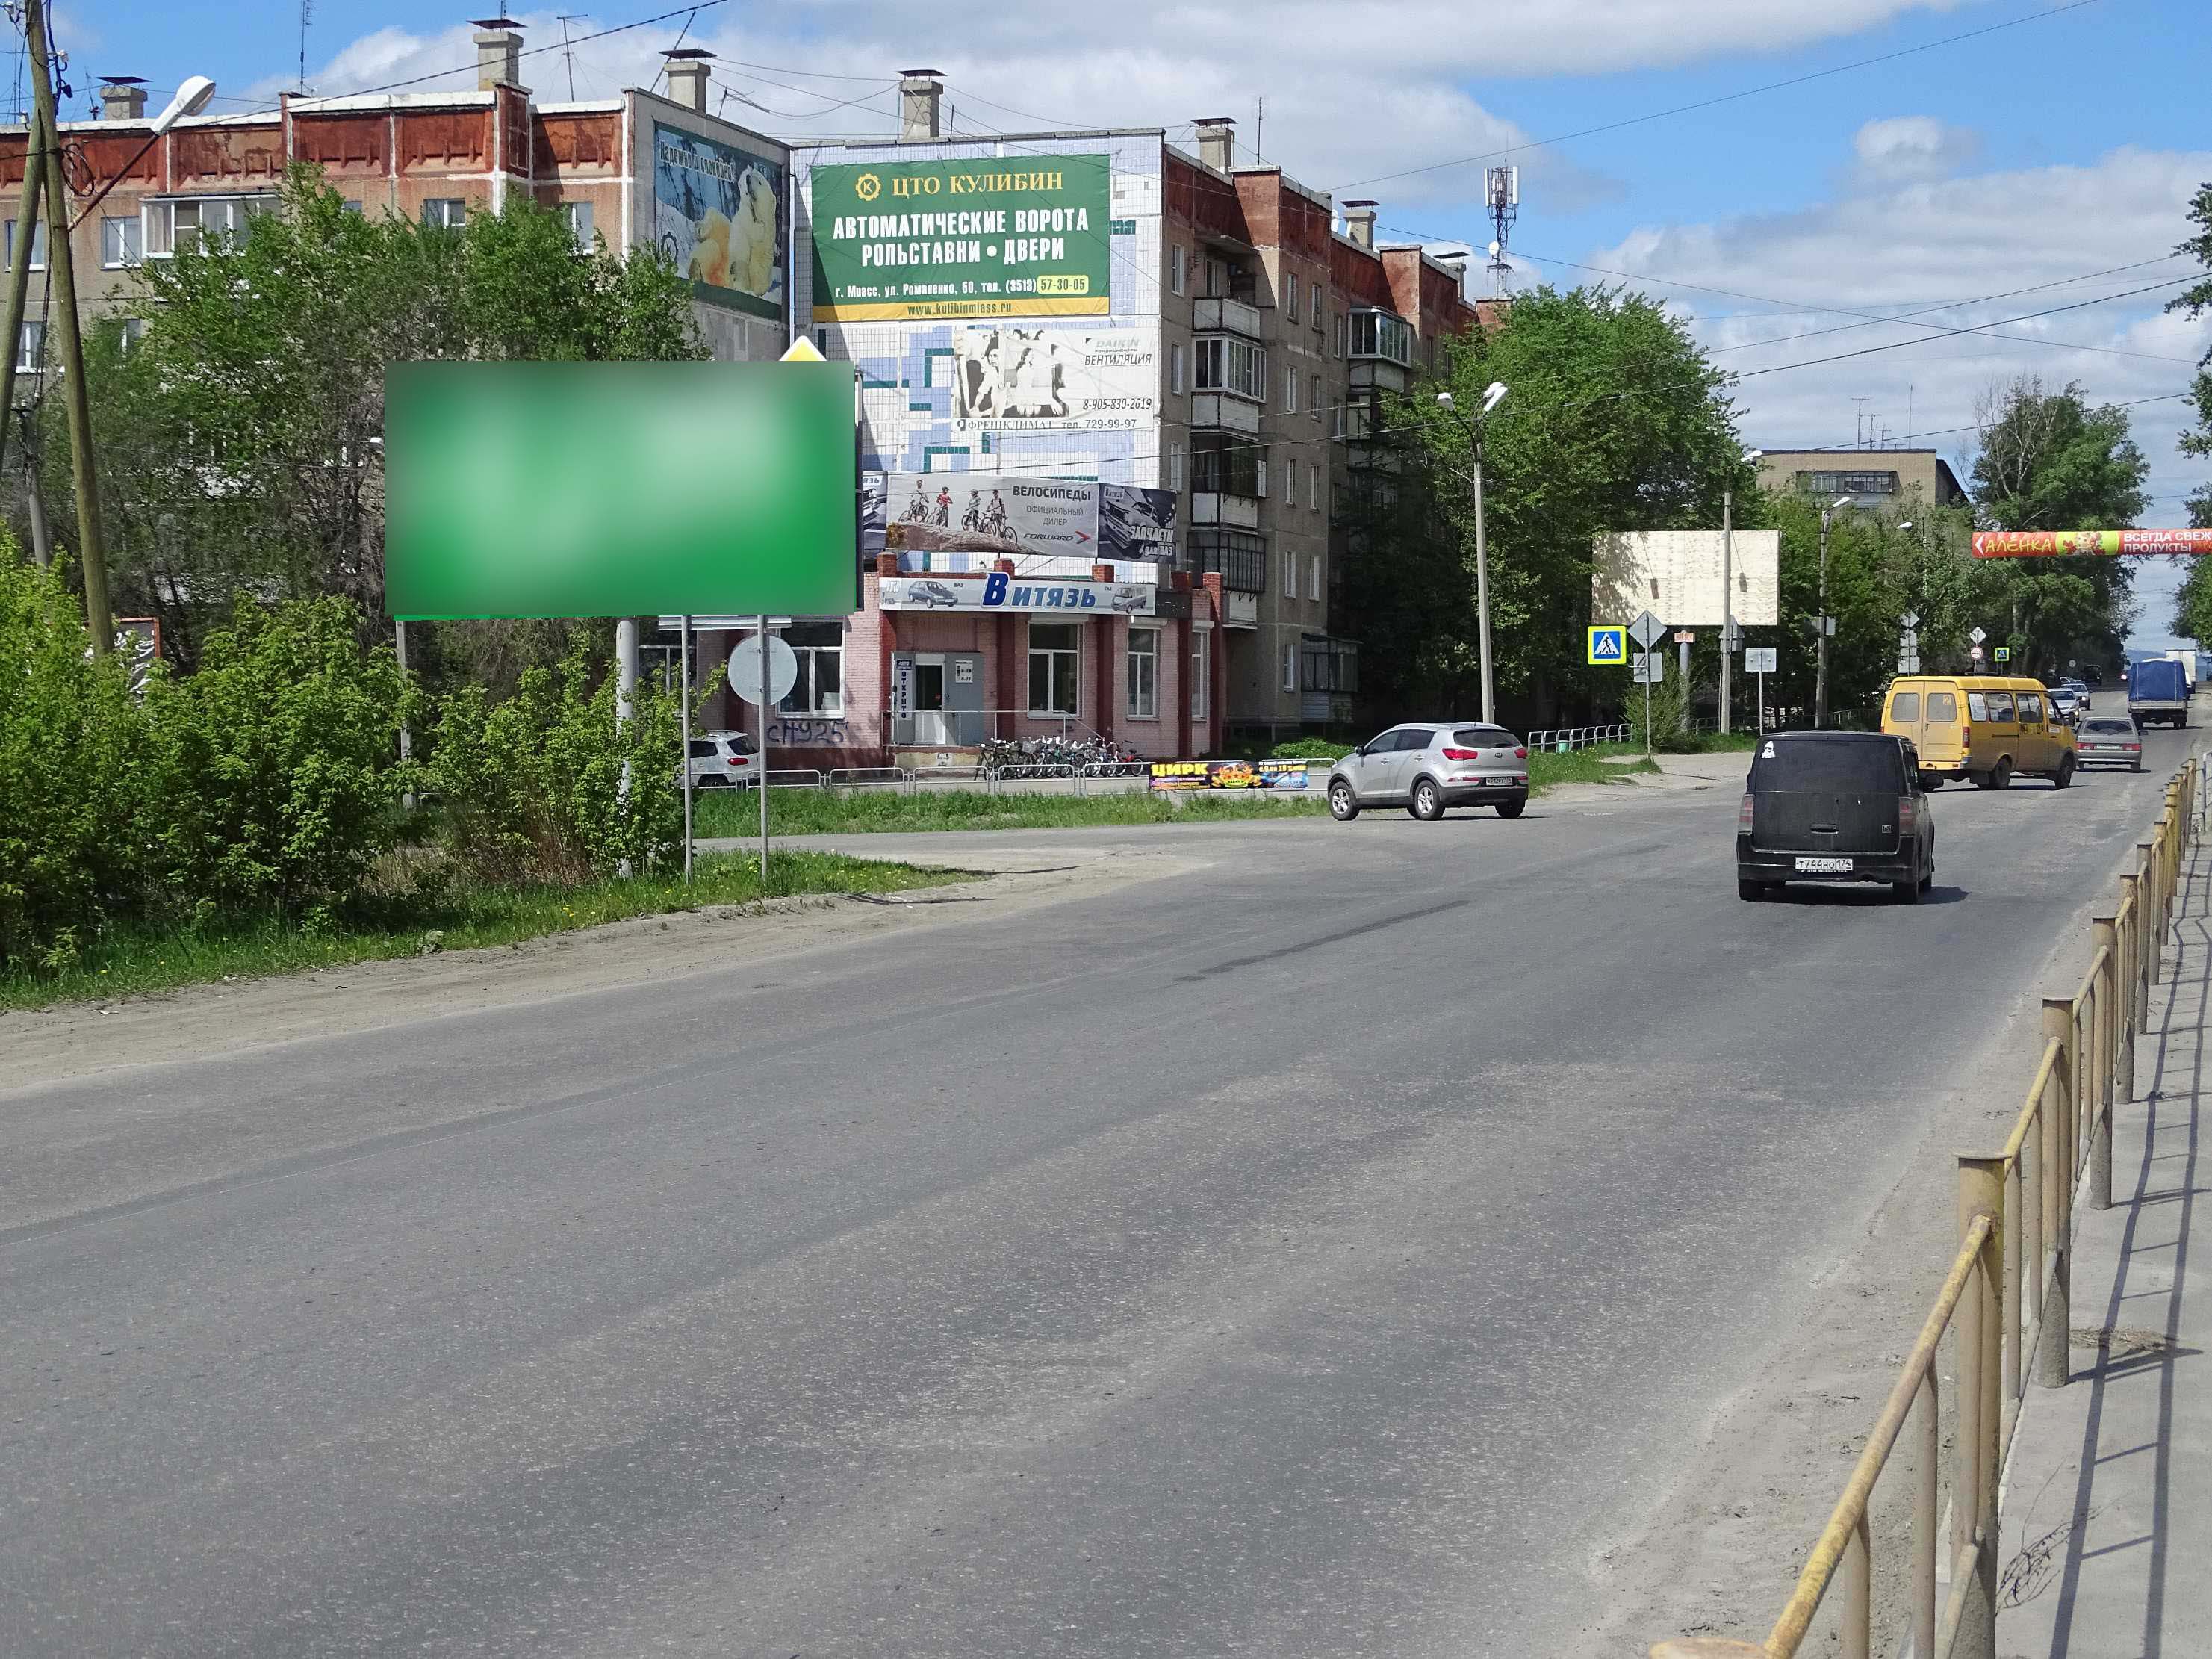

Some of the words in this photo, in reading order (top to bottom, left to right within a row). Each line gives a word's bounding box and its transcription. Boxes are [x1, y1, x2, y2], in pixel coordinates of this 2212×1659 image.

[892, 176, 941, 199] ЦТО
[950, 172, 1064, 195] КУЛИБИН
[833, 211, 1007, 240] АВТОМАТИЧЕСКИЕ
[1015, 207, 1089, 233] ВОРОТА
[862, 241, 981, 267] РОЛЬСТАВНИ
[1004, 238, 1065, 265] ДВЕРИ
[835, 288, 844, 298] г.
[847, 285, 881, 298] Миасс,
[884, 285, 899, 298] ул.
[903, 283, 958, 296] Романенко,
[962, 281, 978, 295] 50,
[981, 281, 1001, 294] тел.
[1040, 279, 1086, 291] 57-30-05
[907, 302, 1012, 316] www.kulibinmiass.ru
[1085, 353, 1152, 365] ВЕНТИЛЯЦИЯ
[1083, 398, 1152, 410] 8-905-830-2619
[1085, 419, 1137, 429] 729-99-97
[1013, 485, 1091, 501] ВЕЛОСИПЕДЫ
[1026, 505, 1084, 515] ОФИЦИАЛЬНЫЙ
[1043, 517, 1068, 526] ДИЛЕР
[1023, 533, 1074, 542] FORWARD
[1129, 525, 1174, 542] ЗАПЧАСТИ
[2124, 531, 2172, 543] ВСЕГДА
[2124, 542, 2192, 553] ПРОДУКТЫ
[1151, 763, 1209, 778] ЦИРК
[1836, 859, 1852, 867] 174
